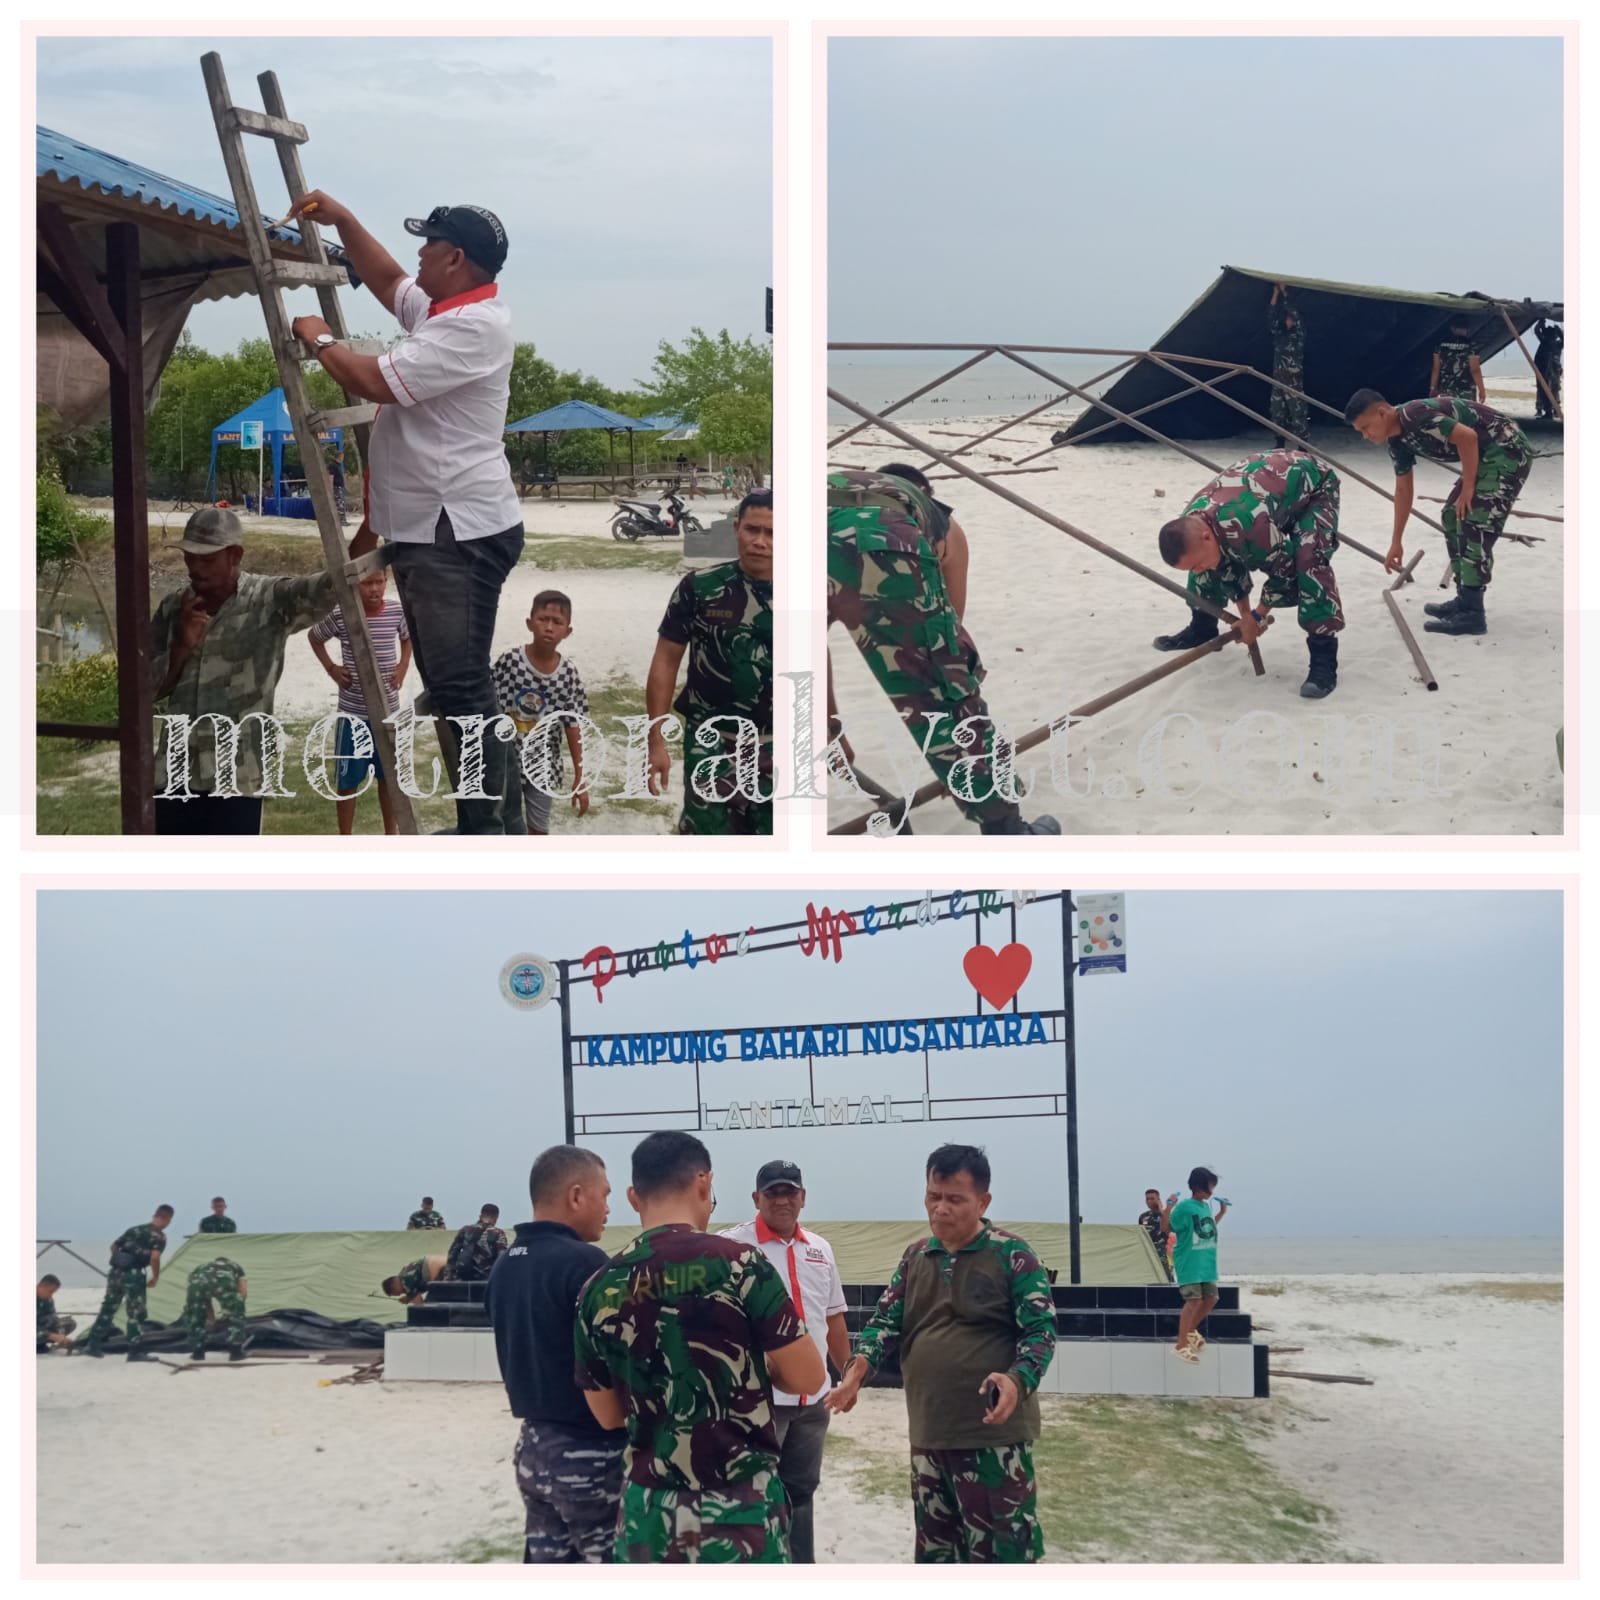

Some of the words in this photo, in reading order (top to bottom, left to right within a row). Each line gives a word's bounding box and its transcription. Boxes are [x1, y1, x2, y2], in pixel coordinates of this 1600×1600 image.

[582, 925, 756, 1004] Pantai
[587, 1030, 728, 1068] KAMPUNG
[740, 1023, 849, 1062] BAHARI
[861, 1011, 1049, 1056] NUSANTARA
[699, 1094, 904, 1131] LANTAMAL
